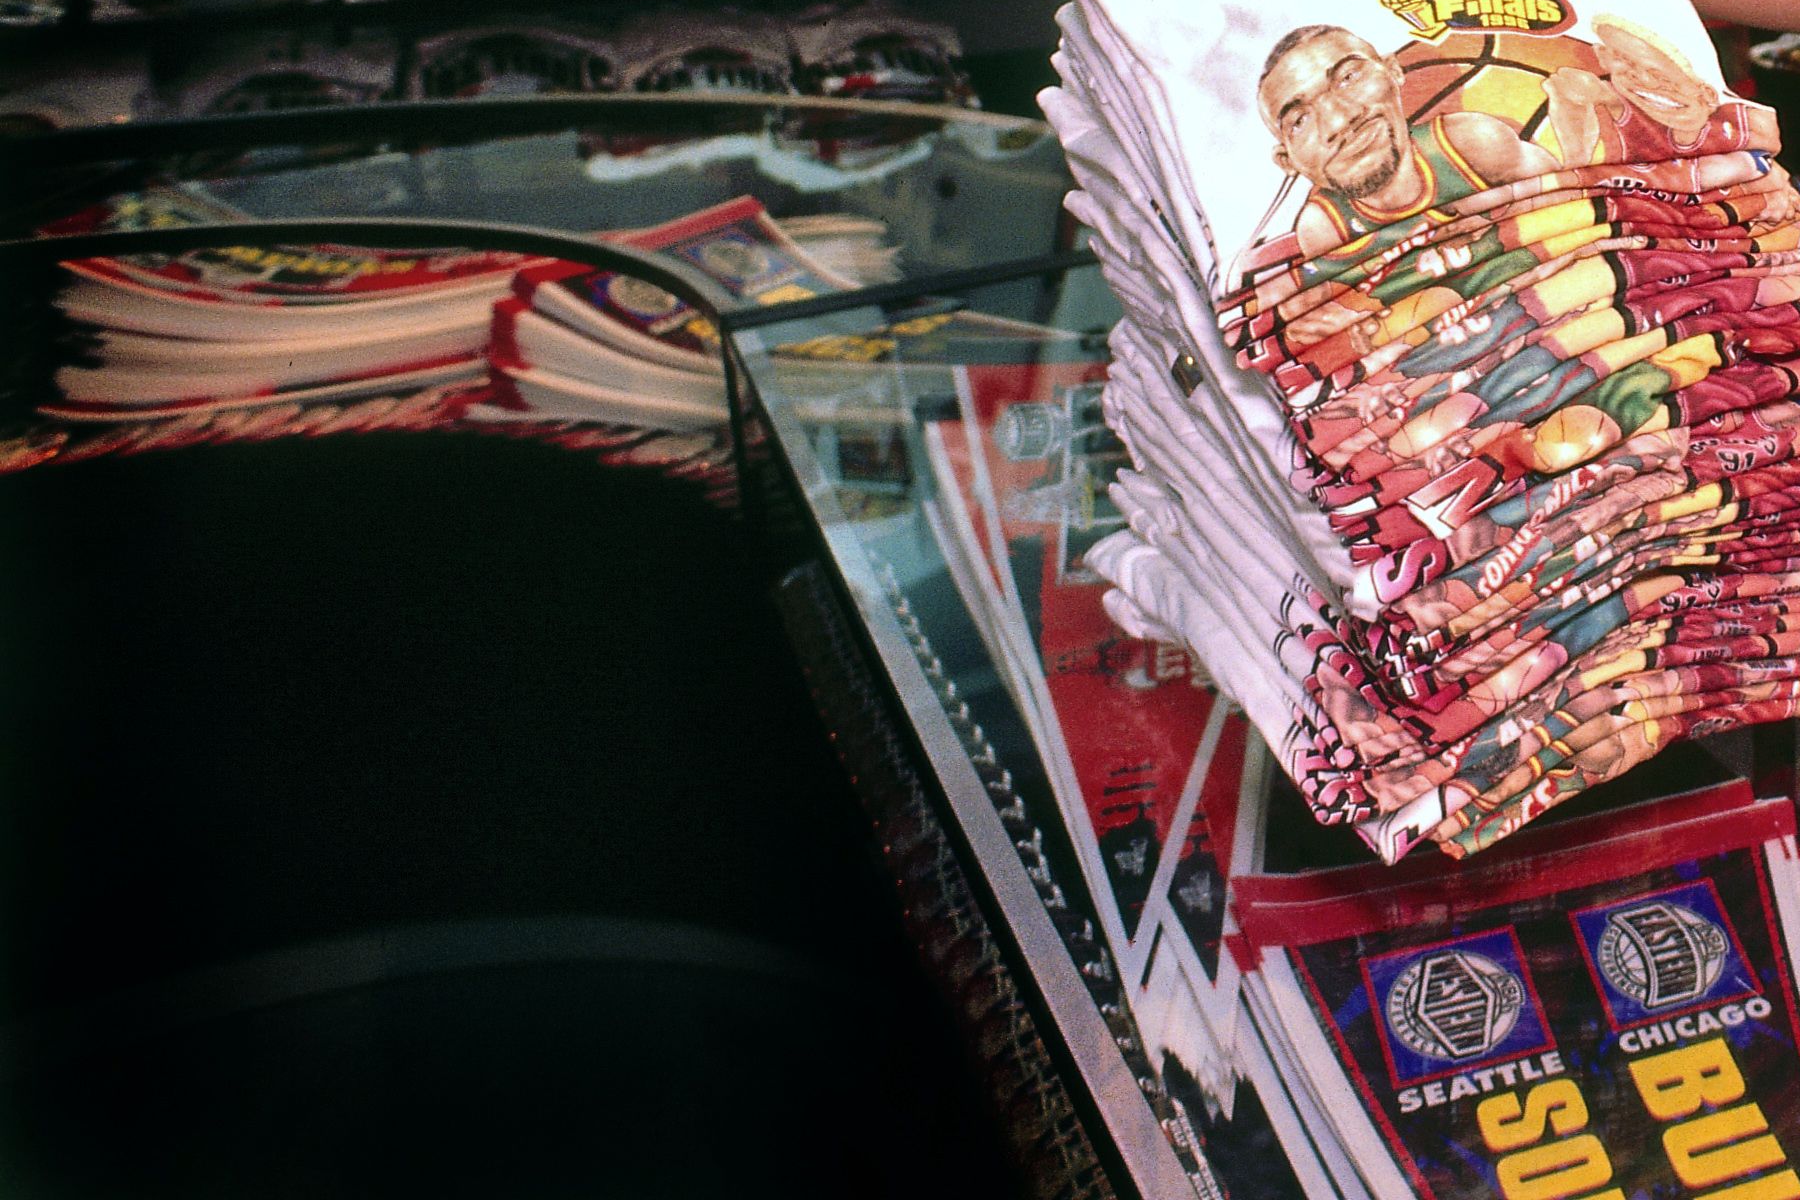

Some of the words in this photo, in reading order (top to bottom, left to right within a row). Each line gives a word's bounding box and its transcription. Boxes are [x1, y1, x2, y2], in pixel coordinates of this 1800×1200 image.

[1480, 14, 1530, 29] 1996
[1624, 910, 1697, 999] EASTERN
[1618, 998, 1773, 1054] CHICAGO
[1397, 1048, 1568, 1114] SEATTLE
[1476, 1077, 1628, 1200] SO
